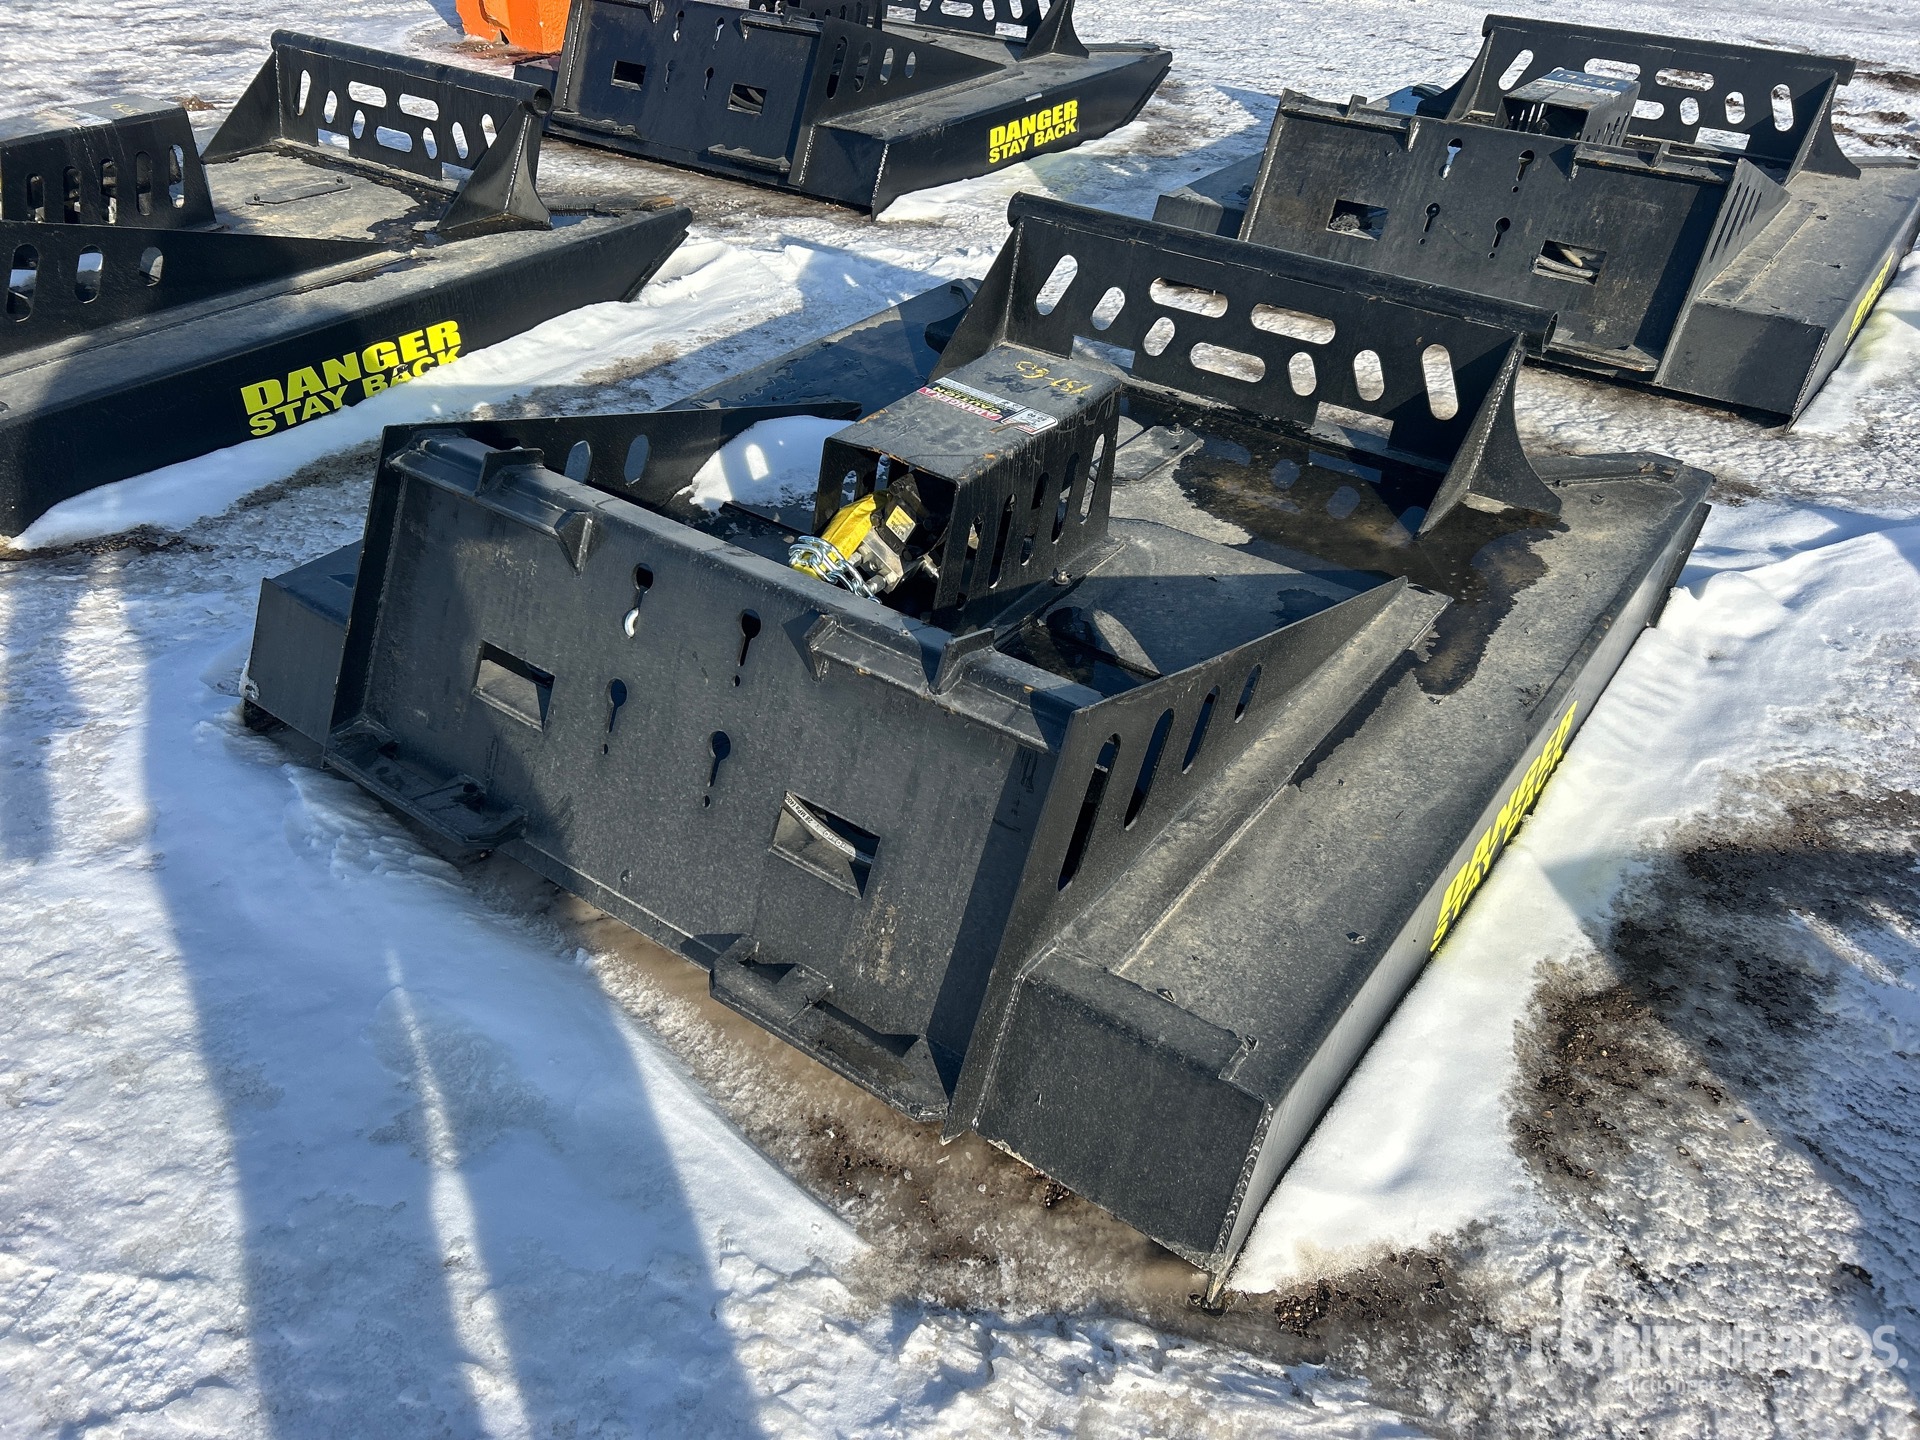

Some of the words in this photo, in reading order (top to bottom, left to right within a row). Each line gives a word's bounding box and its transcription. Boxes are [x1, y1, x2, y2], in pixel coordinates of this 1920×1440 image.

[988, 135, 1030, 164] STAY
[1033, 118, 1077, 148] BACK
[989, 99, 1078, 149] DANGER
[240, 320, 462, 416] DANGER
[248, 384, 349, 436] STAY
[361, 345, 462, 399] BACK
[932, 386, 1001, 414] CAUTION
[1429, 834, 1501, 952] STAY
[1502, 732, 1569, 846] BACK
[1436, 700, 1578, 927] DANGER
